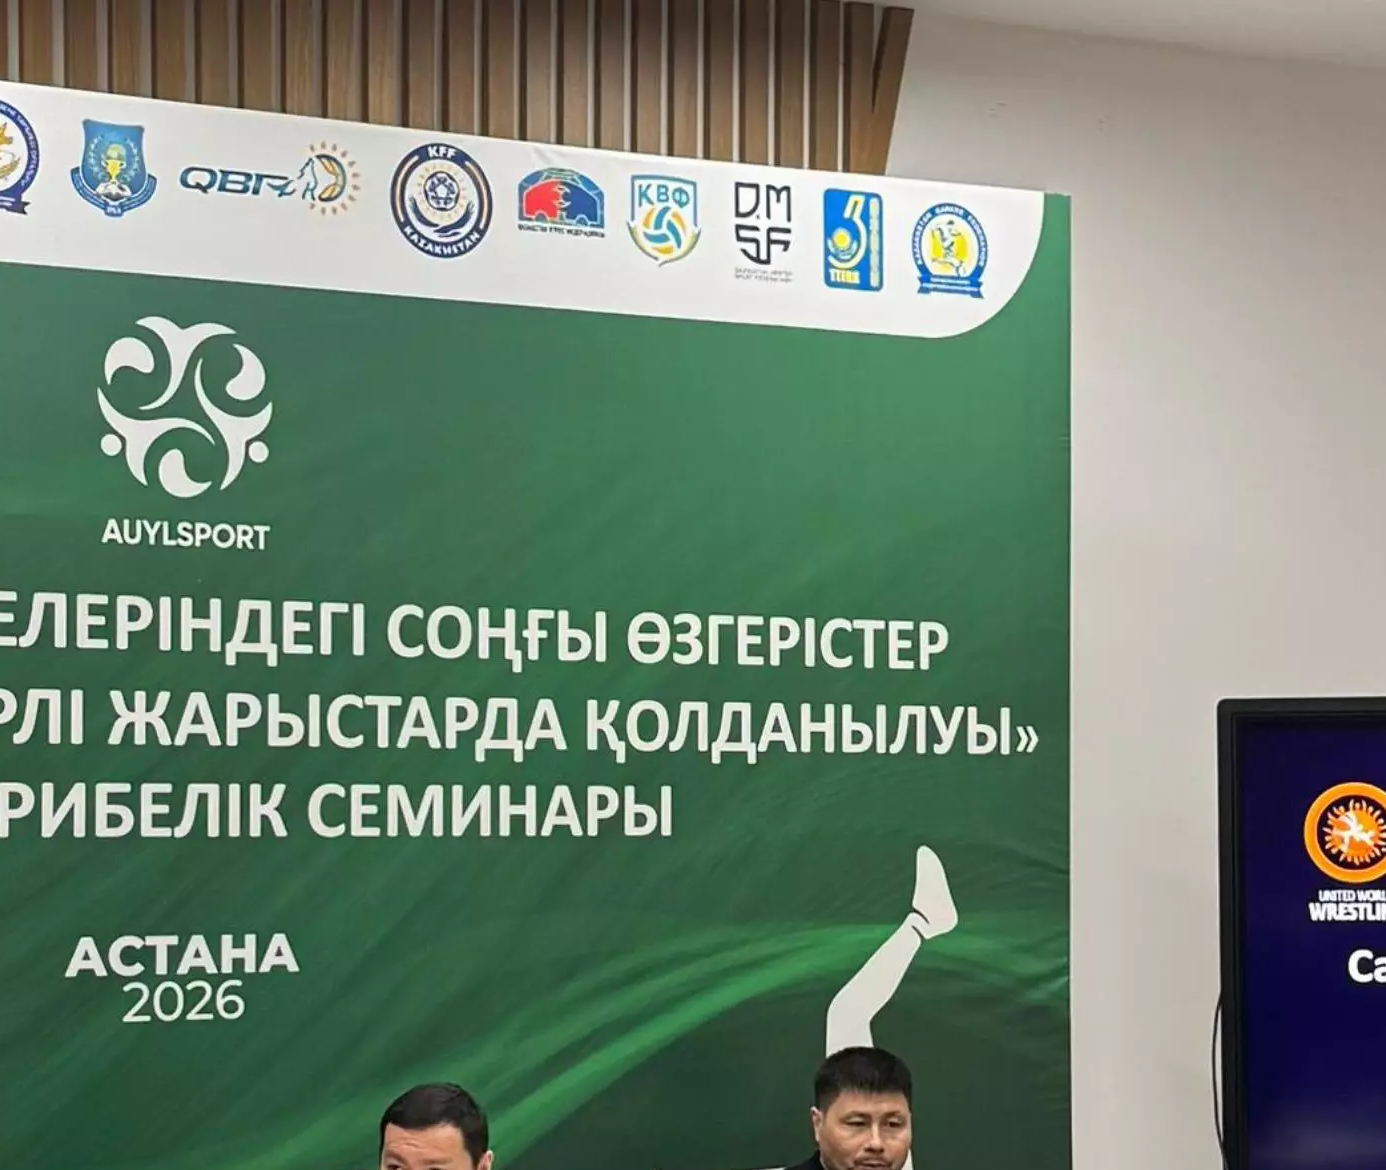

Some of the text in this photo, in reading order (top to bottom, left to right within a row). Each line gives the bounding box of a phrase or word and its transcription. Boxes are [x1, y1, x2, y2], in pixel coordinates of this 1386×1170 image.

[427, 146, 456, 159] KFF
[404, 226, 480, 255] KAZAKHSTAN
[101, 518, 271, 550] AUYLSPORT
[387, 604, 608, 674] СОҢҒЫ
[627, 611, 950, 671] ӨЗГЕРІСТЕР
[106, 690, 568, 763] ЖАРЫСТАРДА
[586, 698, 1040, 766] ҚОЛДАНЫЛУЫ»
[307, 783, 673, 839] СЕМИНАРЫ
[1318, 889, 1355, 902] UNITED
[64, 933, 300, 978] АСТАНА
[122, 979, 246, 1023] 2026
